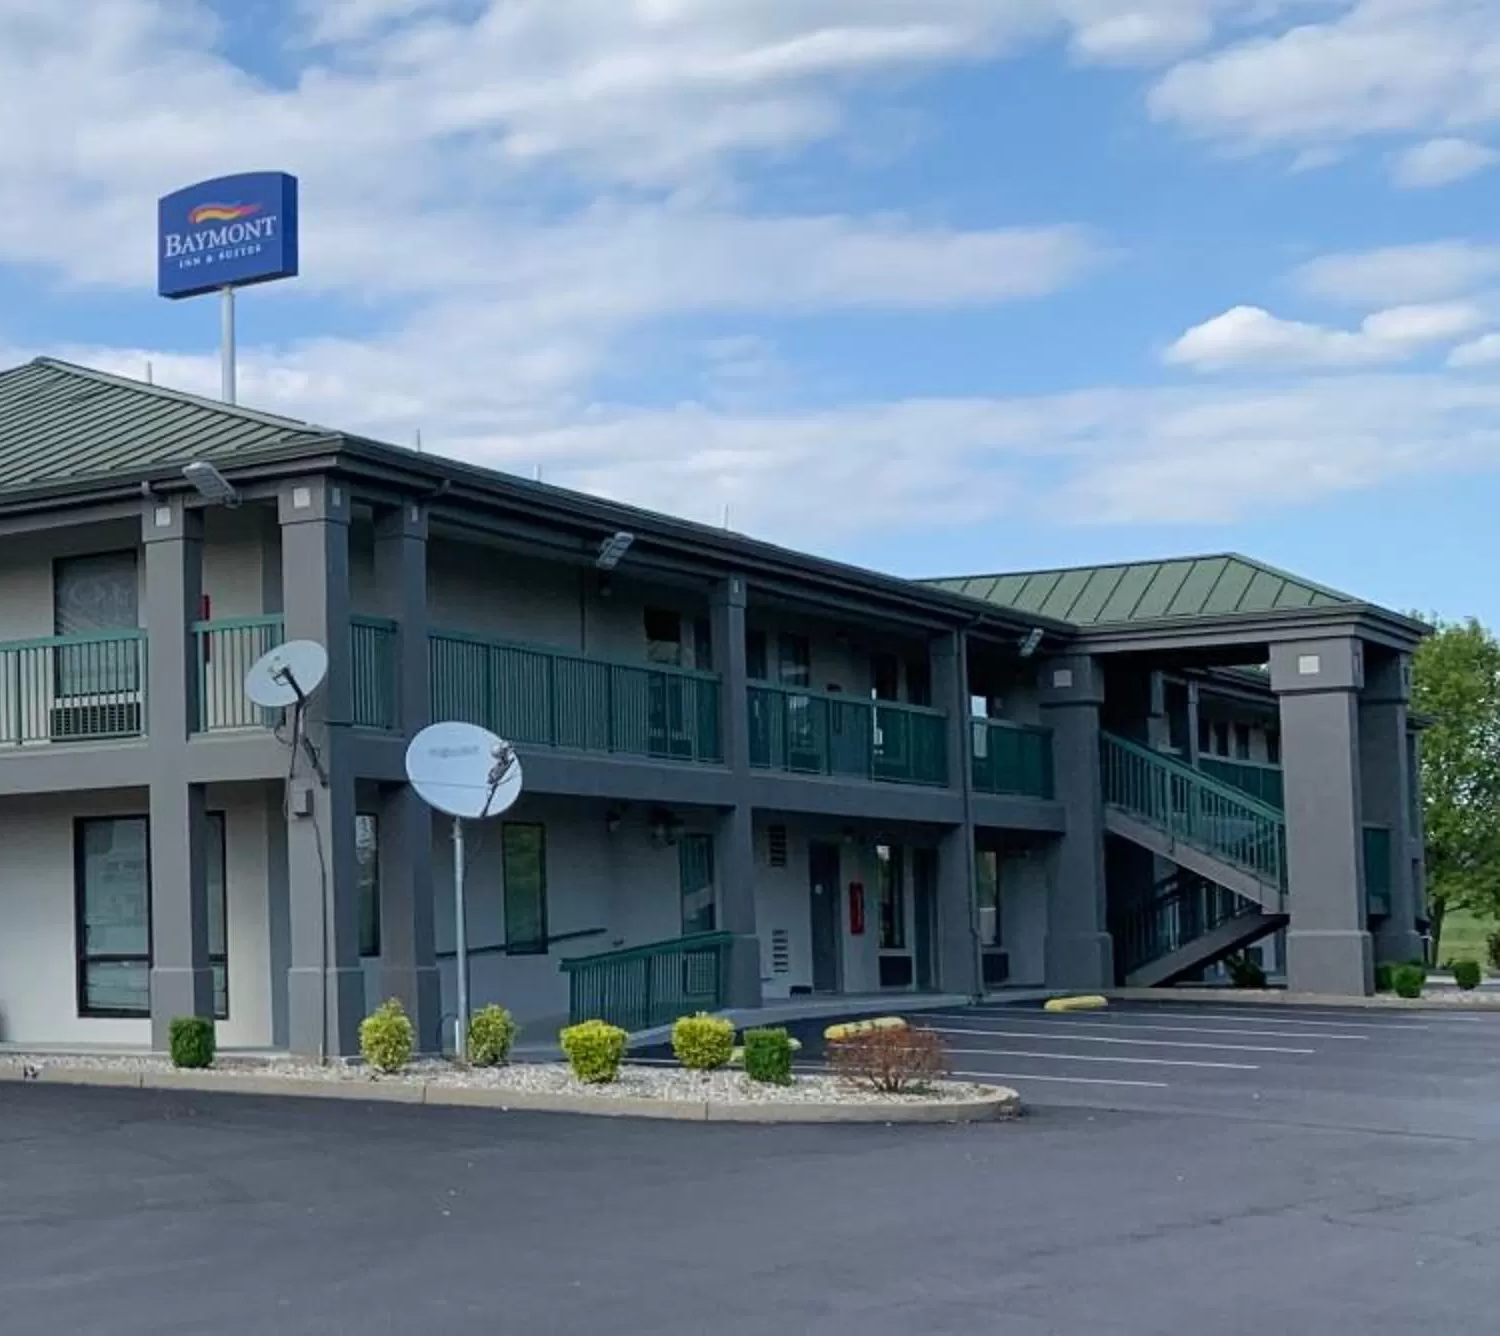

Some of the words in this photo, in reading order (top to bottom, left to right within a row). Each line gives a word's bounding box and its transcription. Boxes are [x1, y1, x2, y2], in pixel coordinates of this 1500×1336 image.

[164, 215, 277, 258] BAYMONT
[179, 257, 201, 269] INN
[218, 243, 261, 260] SUITES
